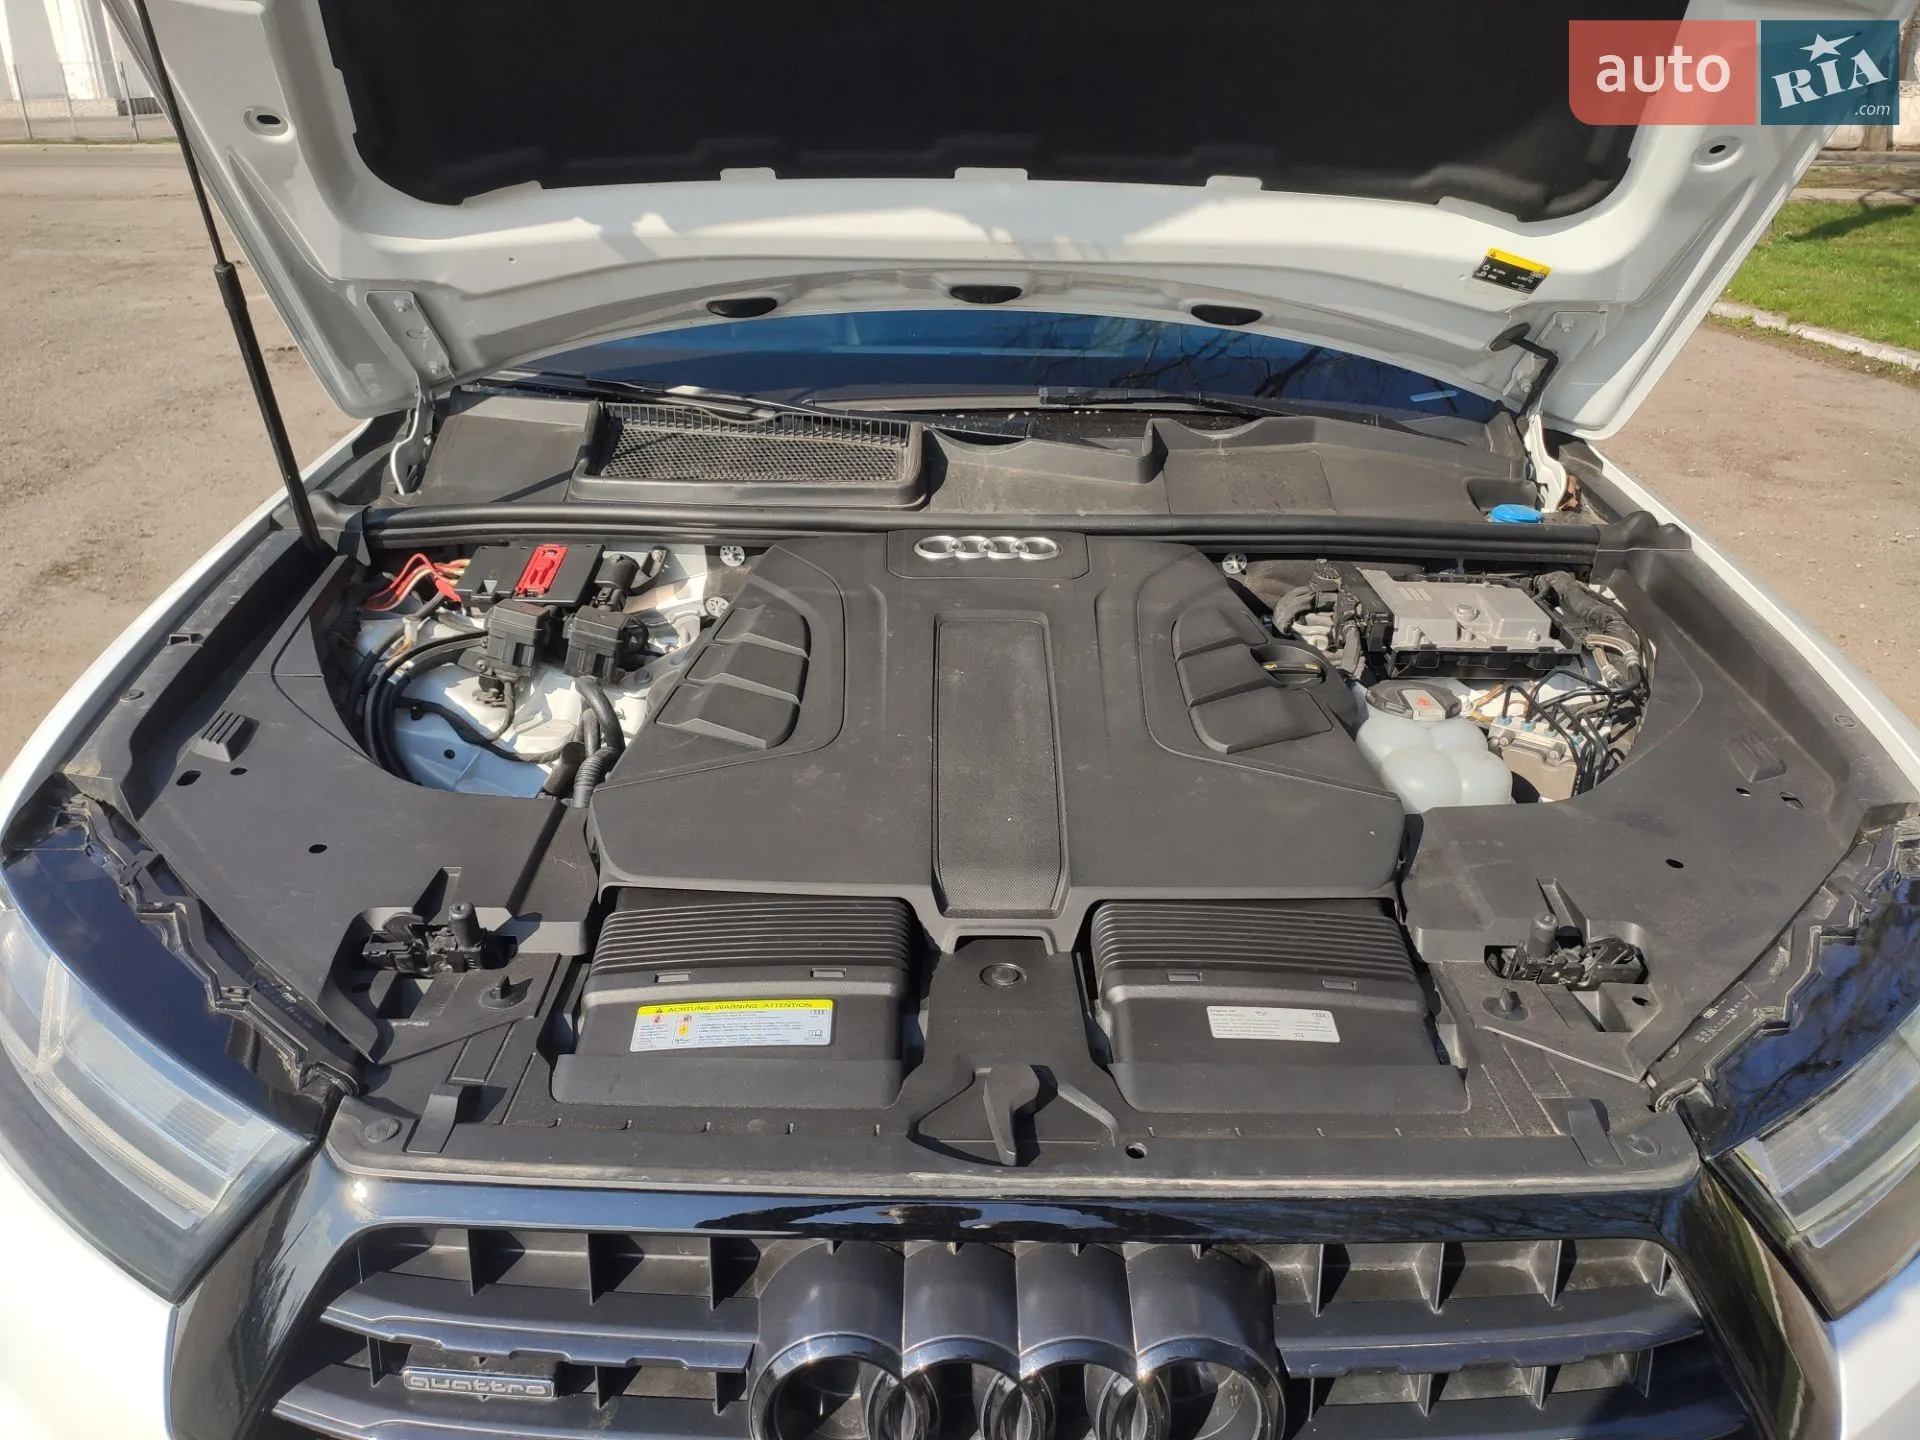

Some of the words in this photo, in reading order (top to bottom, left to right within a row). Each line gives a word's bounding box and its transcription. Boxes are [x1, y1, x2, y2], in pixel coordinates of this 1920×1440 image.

[667, 1005, 710, 1013] ACHTUNG
[715, 1003, 759, 1011] WARNING
[410, 1376, 547, 1395] quattro
